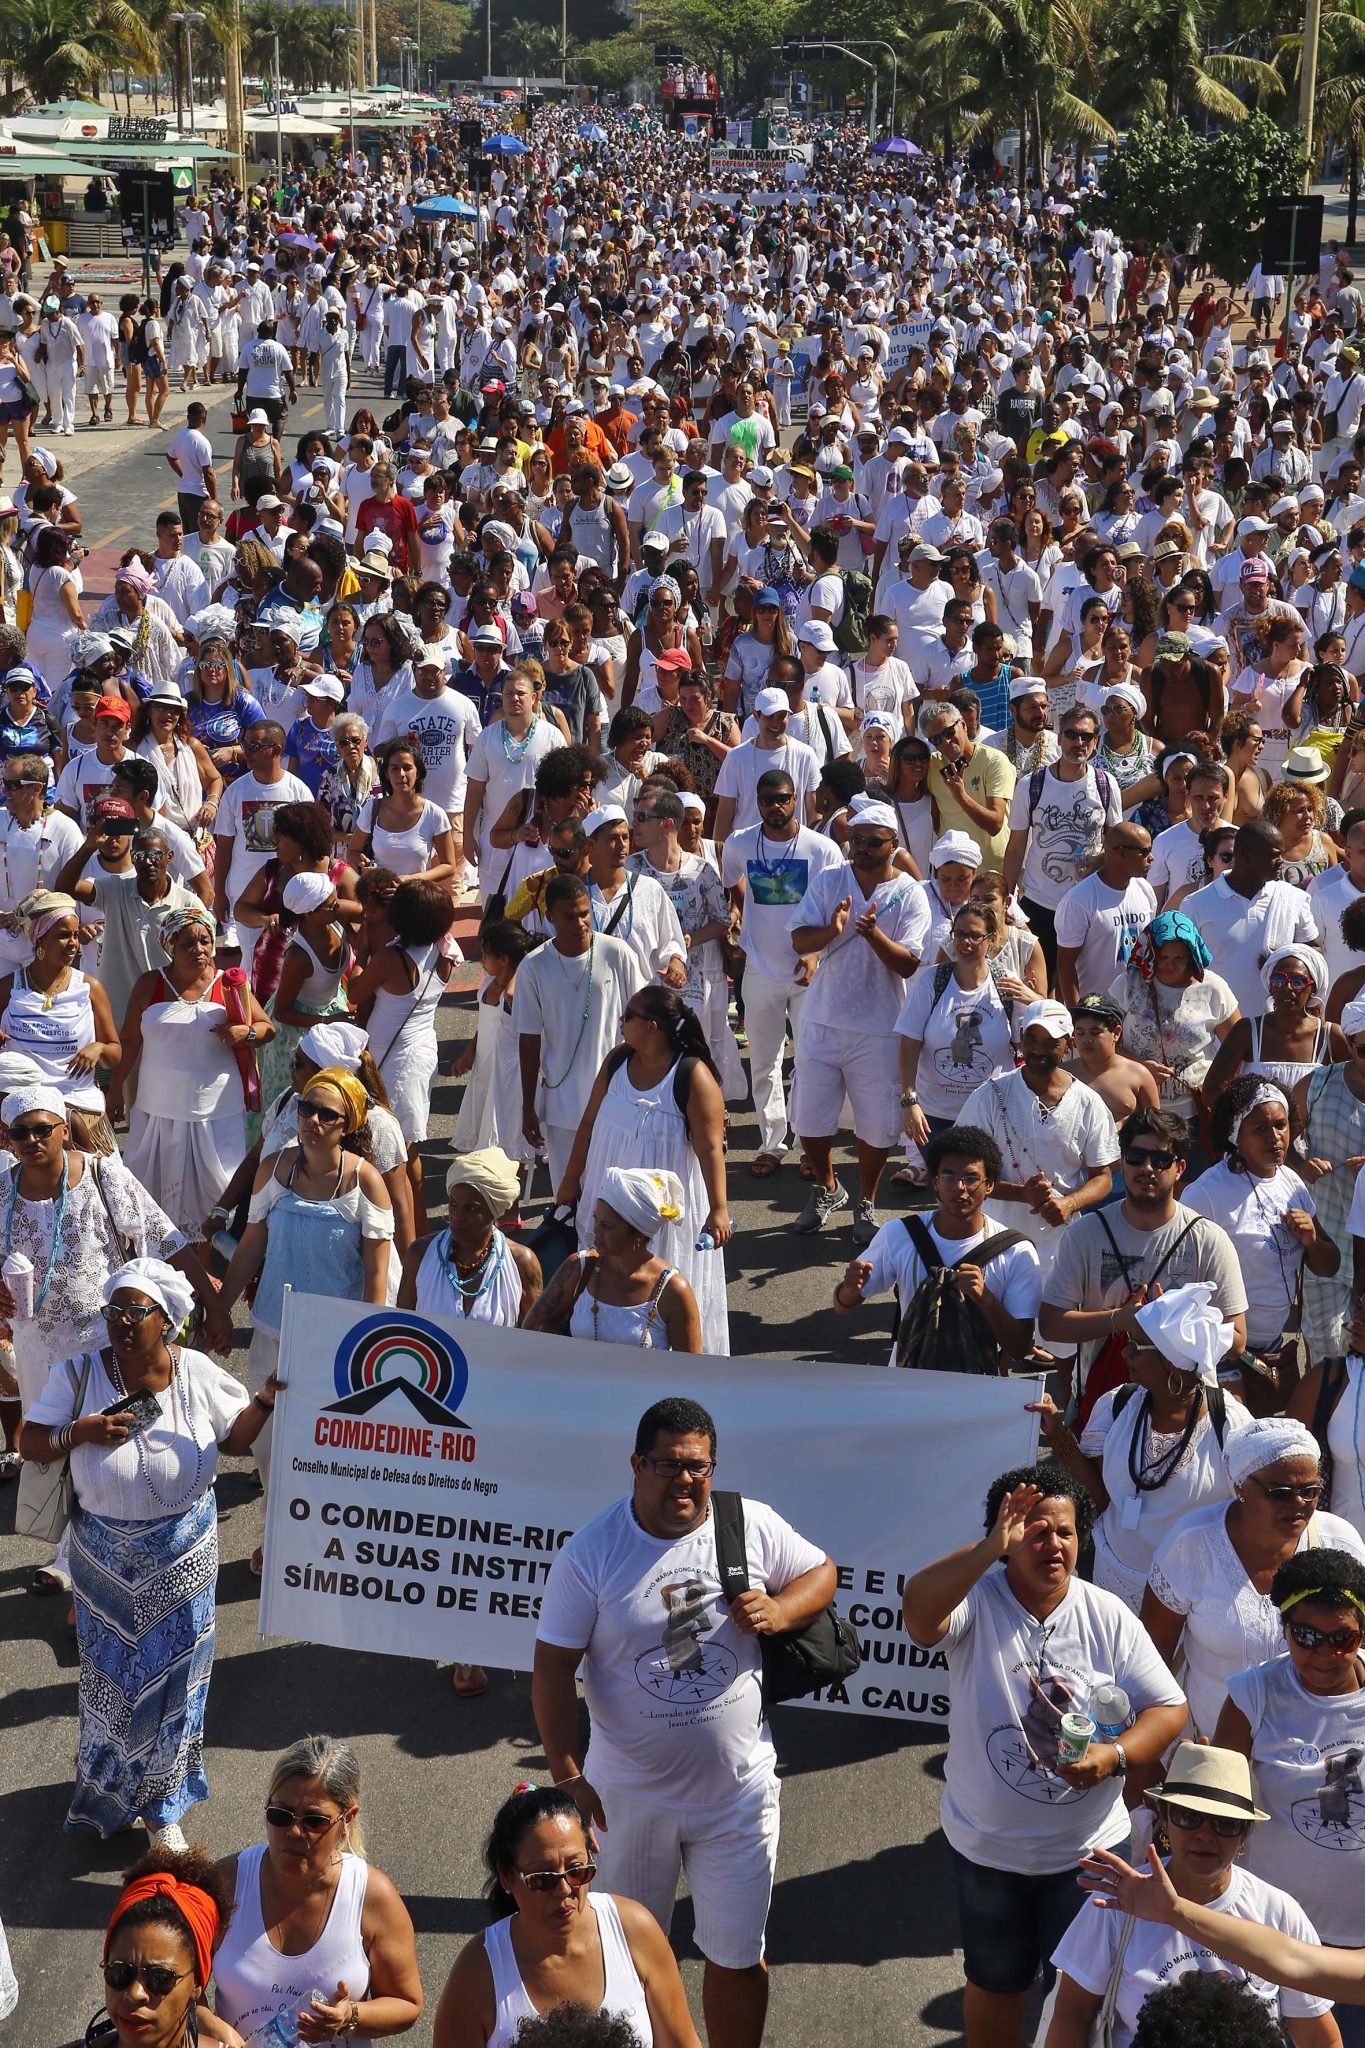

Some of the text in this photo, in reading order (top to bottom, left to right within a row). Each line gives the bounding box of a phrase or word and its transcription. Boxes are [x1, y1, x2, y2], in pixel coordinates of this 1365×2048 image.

[109, 117, 168, 131] BUENOS
[1010, 399, 1036, 409] RAIDERS
[408, 715, 456, 732] STATE
[863, 716, 891, 731] PAZ
[446, 734, 457, 745] 83
[421, 746, 451, 756] ARTER
[424, 756, 443, 766] ACK
[314, 1417, 476, 1462] COMDEDINE-RIO
[292, 1457, 498, 1496] Conselho Municipal de Defesa dos Direitos do Negro
[289, 1498, 311, 1521] O
[835, 1565, 855, 1590] E
[865, 1570, 885, 1594] E
[323, 1537, 345, 1561] A
[355, 1541, 440, 1572] SUAS
[451, 1552, 553, 1586] INSTIT
[655, 1570, 673, 1583] MARIA
[674, 1566, 695, 1574] CONGA
[283, 1563, 950, 1671] SÍMBOLO DE RES NUIDA
[861, 1686, 950, 1716] CAUS
[685, 1708, 700, 1717] seja
[701, 1703, 723, 1712] nosso
[668, 1720, 688, 1729] Jesus
[1156, 1961, 1174, 1982] VOVÓ
[1173, 1951, 1199, 1965] MARIA
[271, 1983, 283, 1993] Pai
